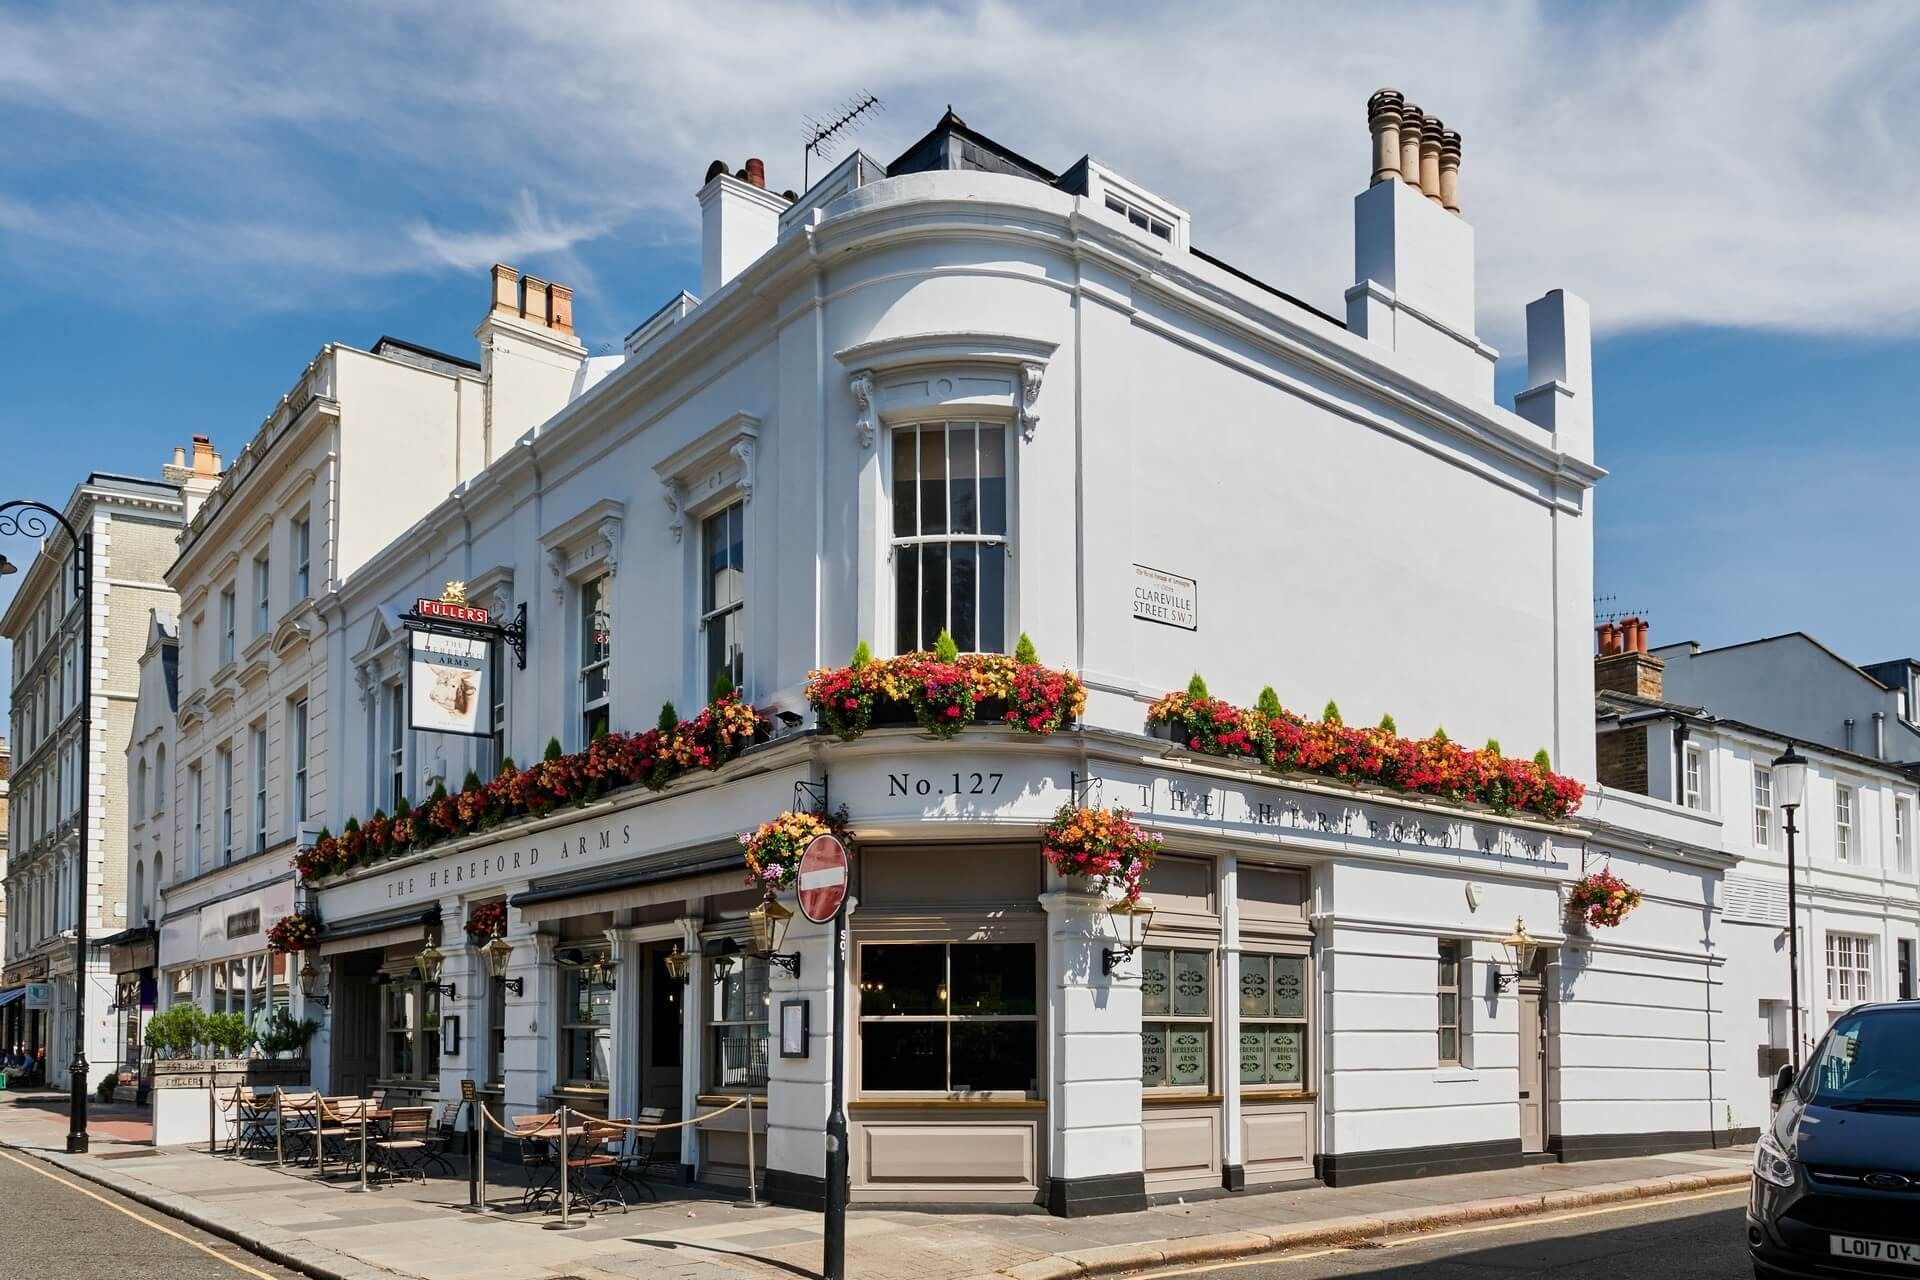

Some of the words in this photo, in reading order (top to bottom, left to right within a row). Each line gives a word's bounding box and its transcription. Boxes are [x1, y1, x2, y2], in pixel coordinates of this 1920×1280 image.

[1134, 587, 1191, 611] CLAREVILLE
[439, 657, 470, 667] ARMS
[1138, 785, 1214, 816] THE
[1258, 803, 1452, 848] HEREFORD
[1481, 838, 1557, 865] ARMS
[387, 878, 414, 899] THE
[430, 848, 539, 888] HEREFORD
[561, 825, 631, 859] ARMS
[1180, 1055, 1196, 1063] ARMS
[1277, 1054, 1292, 1062] ARMS
